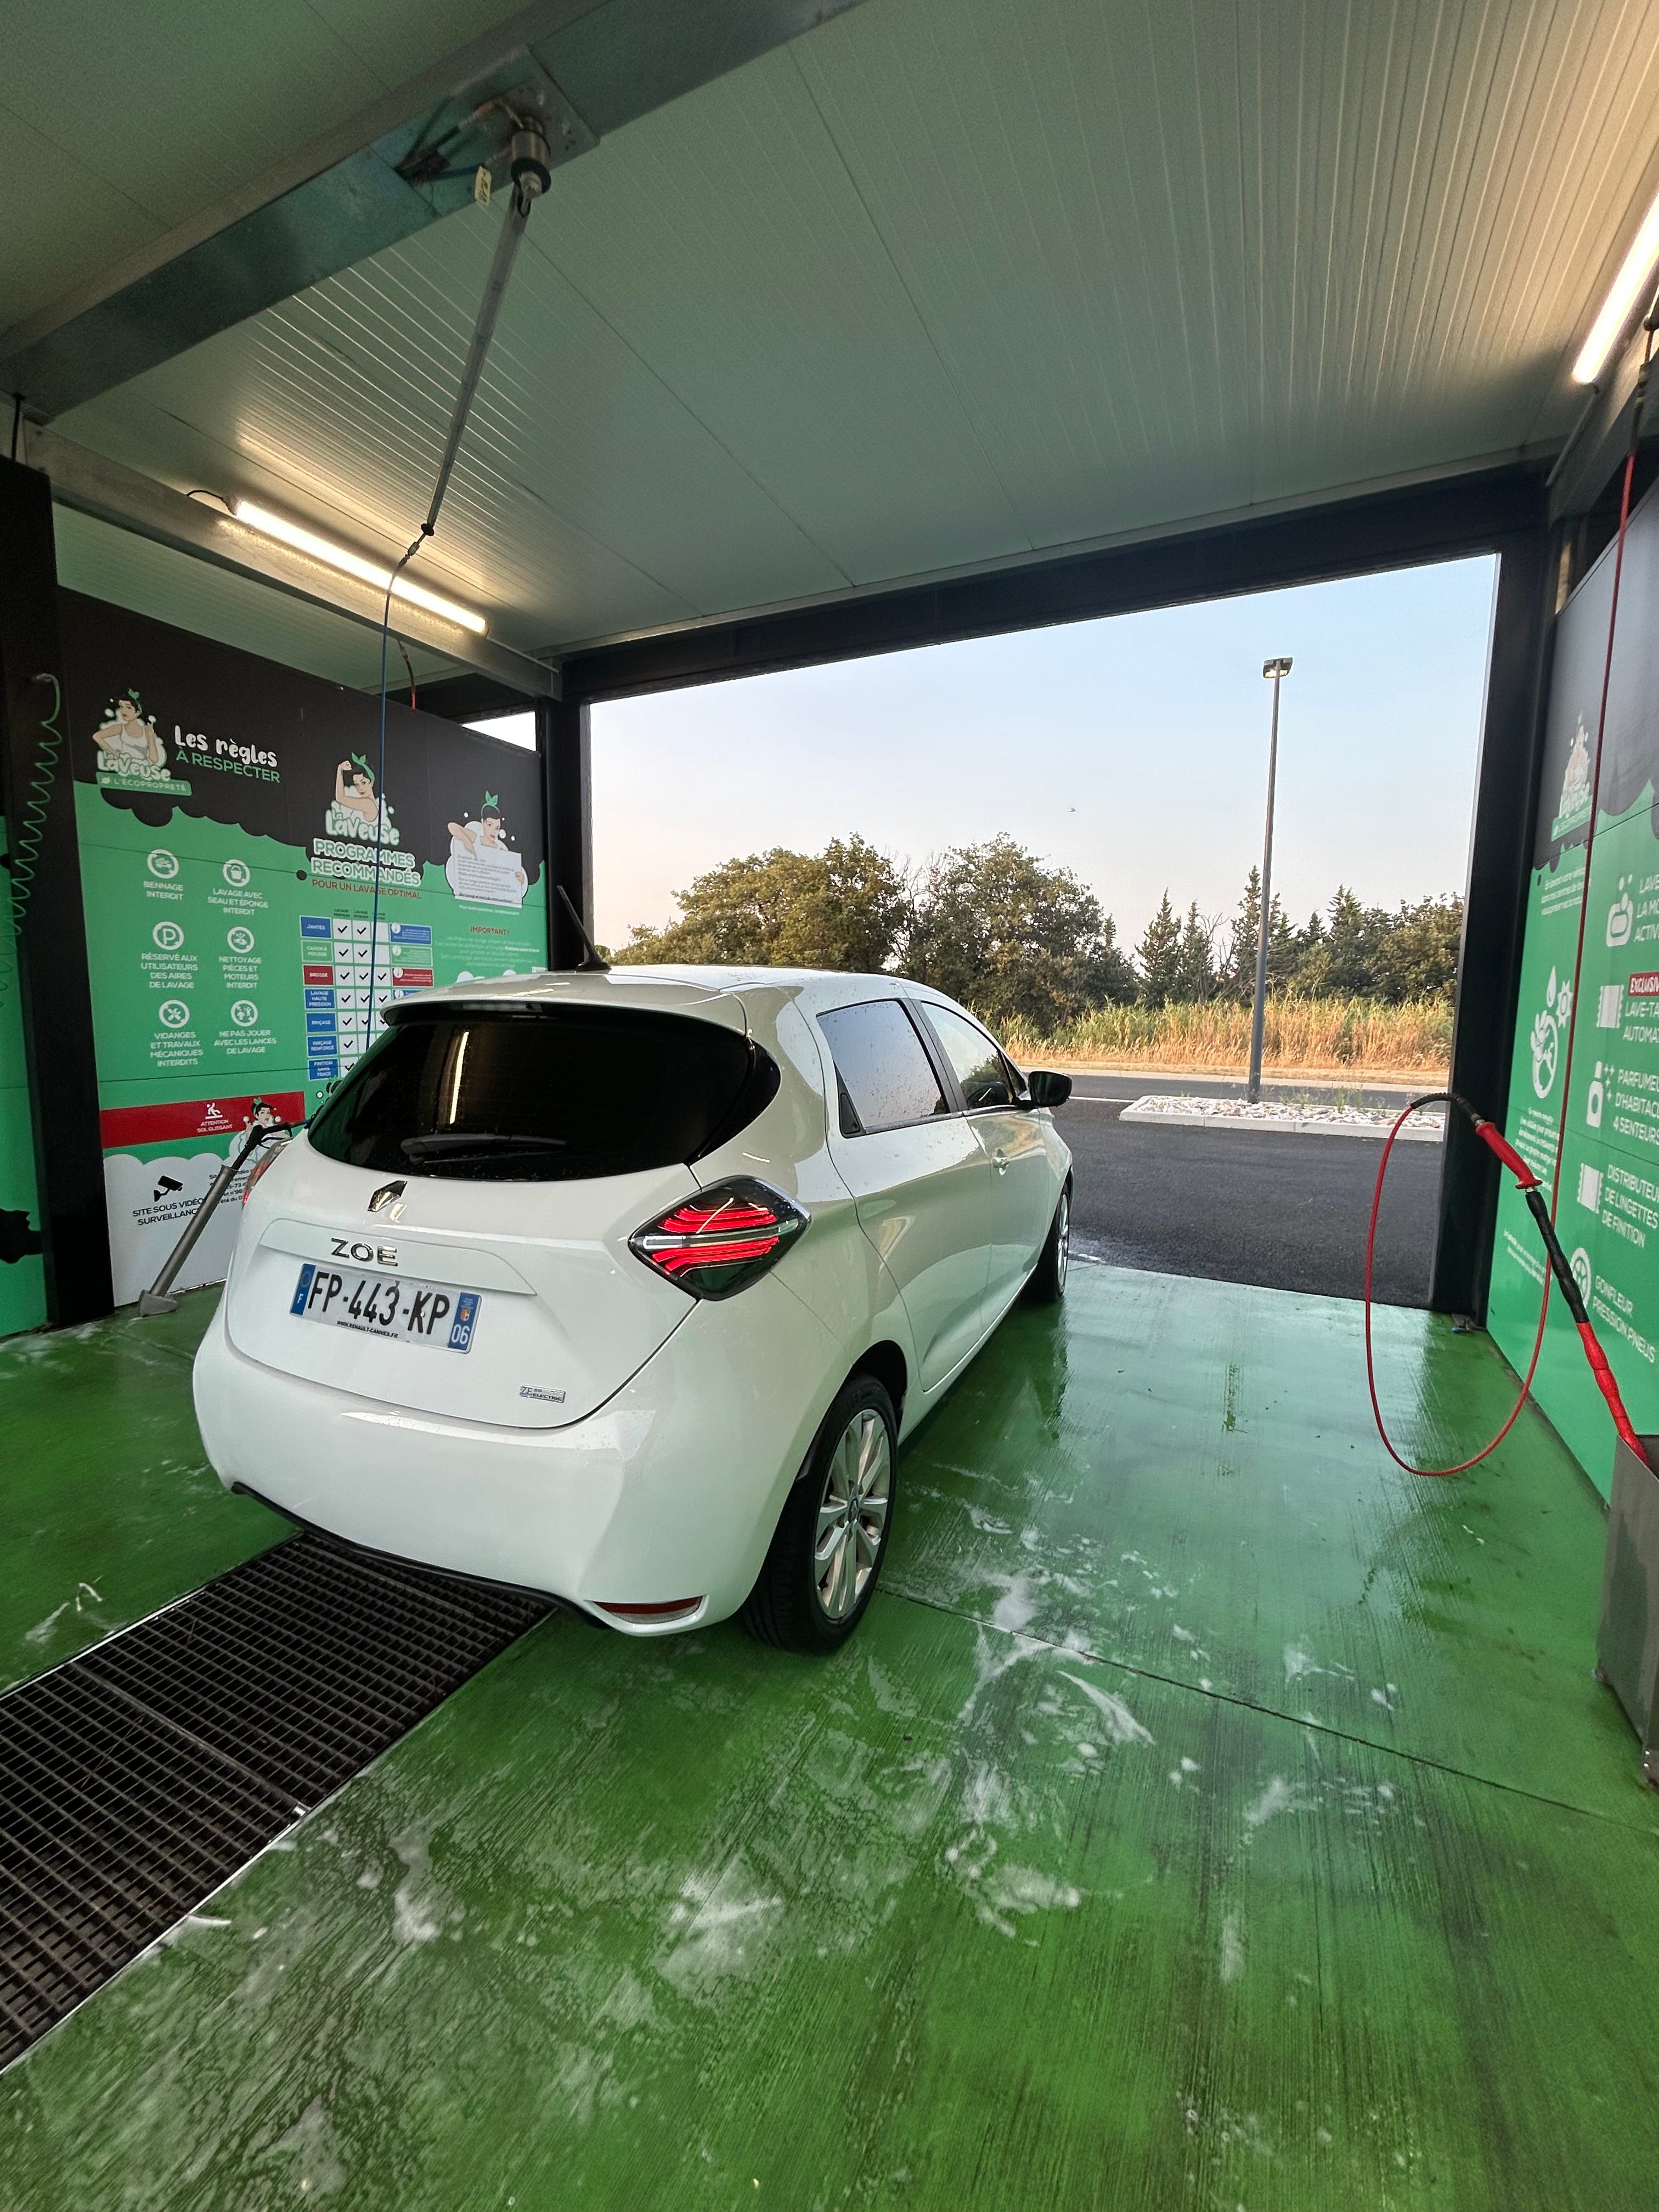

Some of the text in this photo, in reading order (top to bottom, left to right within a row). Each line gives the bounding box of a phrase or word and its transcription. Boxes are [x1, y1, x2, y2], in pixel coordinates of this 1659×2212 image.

[175, 725, 278, 767] Les règles
[176, 747, 280, 783] À RESPECTER
[314, 839, 416, 868] PROGRAMMES
[312, 857, 421, 887] RECOMMANDÉS
[143, 881, 183, 891] BENNAGE
[146, 891, 183, 900] INTERDIT
[213, 888, 242, 898] LAVAGE
[312, 879, 337, 890] POUR
[388, 889, 422, 899] OPTIMAL
[207, 896, 228, 905] SEAU
[223, 907, 255, 916] INTERDIT
[470, 926, 506, 935] IMPORTANT
[142, 952, 180, 961] RÉSERVÉ
[163, 1040, 201, 1048] TRAVAUX
[1623, 1025, 1659, 1043] AUTOMA
[157, 1058, 198, 1067] INTERDITS
[133, 1197, 205, 1217] SITE SOUS VIDÉO
[138, 1208, 199, 1226] SURVEILLANC
[1605, 1187, 1658, 1229] DE LINGETTES
[1602, 1209, 1646, 1249] DE FINITION
[331, 1238, 398, 1266] ZOE
[1595, 1275, 1633, 1318] GONFLEUR
[297, 1294, 303, 1304] F
[308, 1271, 450, 1335] FP-443-KP
[452, 1324, 470, 1344] 06
[1593, 1296, 1655, 1363] PRESSION PNEUS
